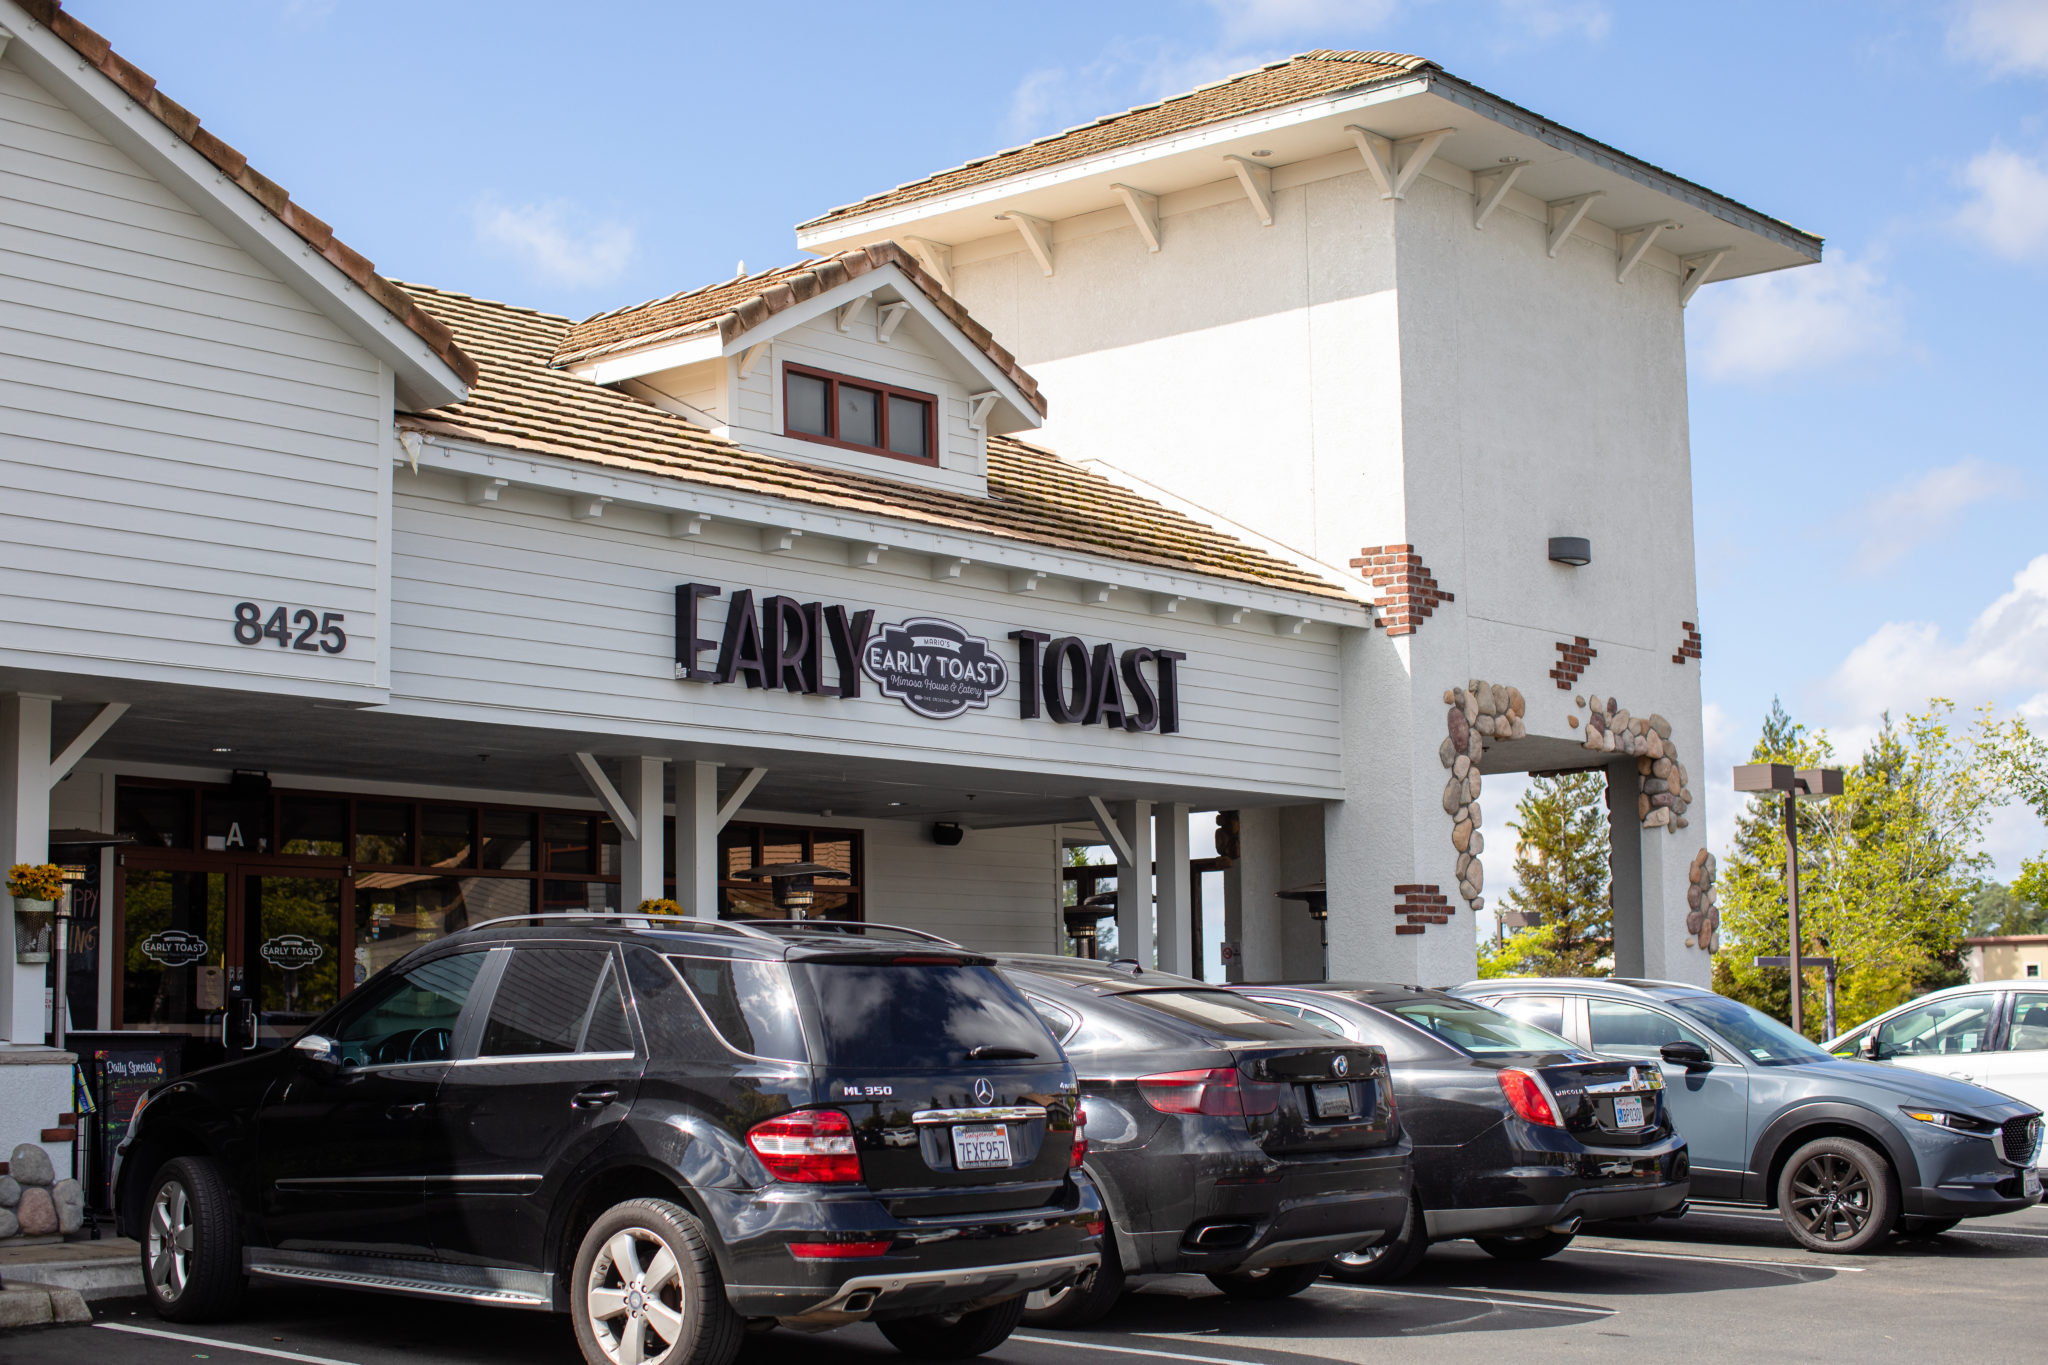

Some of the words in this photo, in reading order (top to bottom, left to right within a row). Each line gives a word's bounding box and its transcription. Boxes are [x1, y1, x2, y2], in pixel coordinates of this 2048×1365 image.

[234, 602, 347, 654] 8425
[923, 638, 950, 648] MARIO'S
[675, 582, 875, 699] EARLY
[1007, 629, 1187, 734] TOAST
[870, 647, 932, 677] EARLY
[936, 656, 1000, 685] TOAST
[890, 674, 924, 689] Mimosa
[924, 678, 950, 692] House
[950, 683, 958, 692] &
[957, 683, 983, 699] Eatery
[225, 822, 245, 847] A
[72, 887, 99, 918] PPY
[144, 942, 172, 952] EARLY
[174, 943, 204, 953] TOAST
[263, 946, 289, 956] EARLY
[290, 947, 319, 957] TOAST
[106, 1060, 128, 1077] Daily
[128, 1060, 158, 1077] Specials
[1369, 1066, 1386, 1077] X6
[843, 1086, 862, 1096] ML
[864, 1085, 893, 1096] 350
[1555, 1088, 1584, 1097] LINCOLN
[958, 1140, 1006, 1161] 7FXF957
